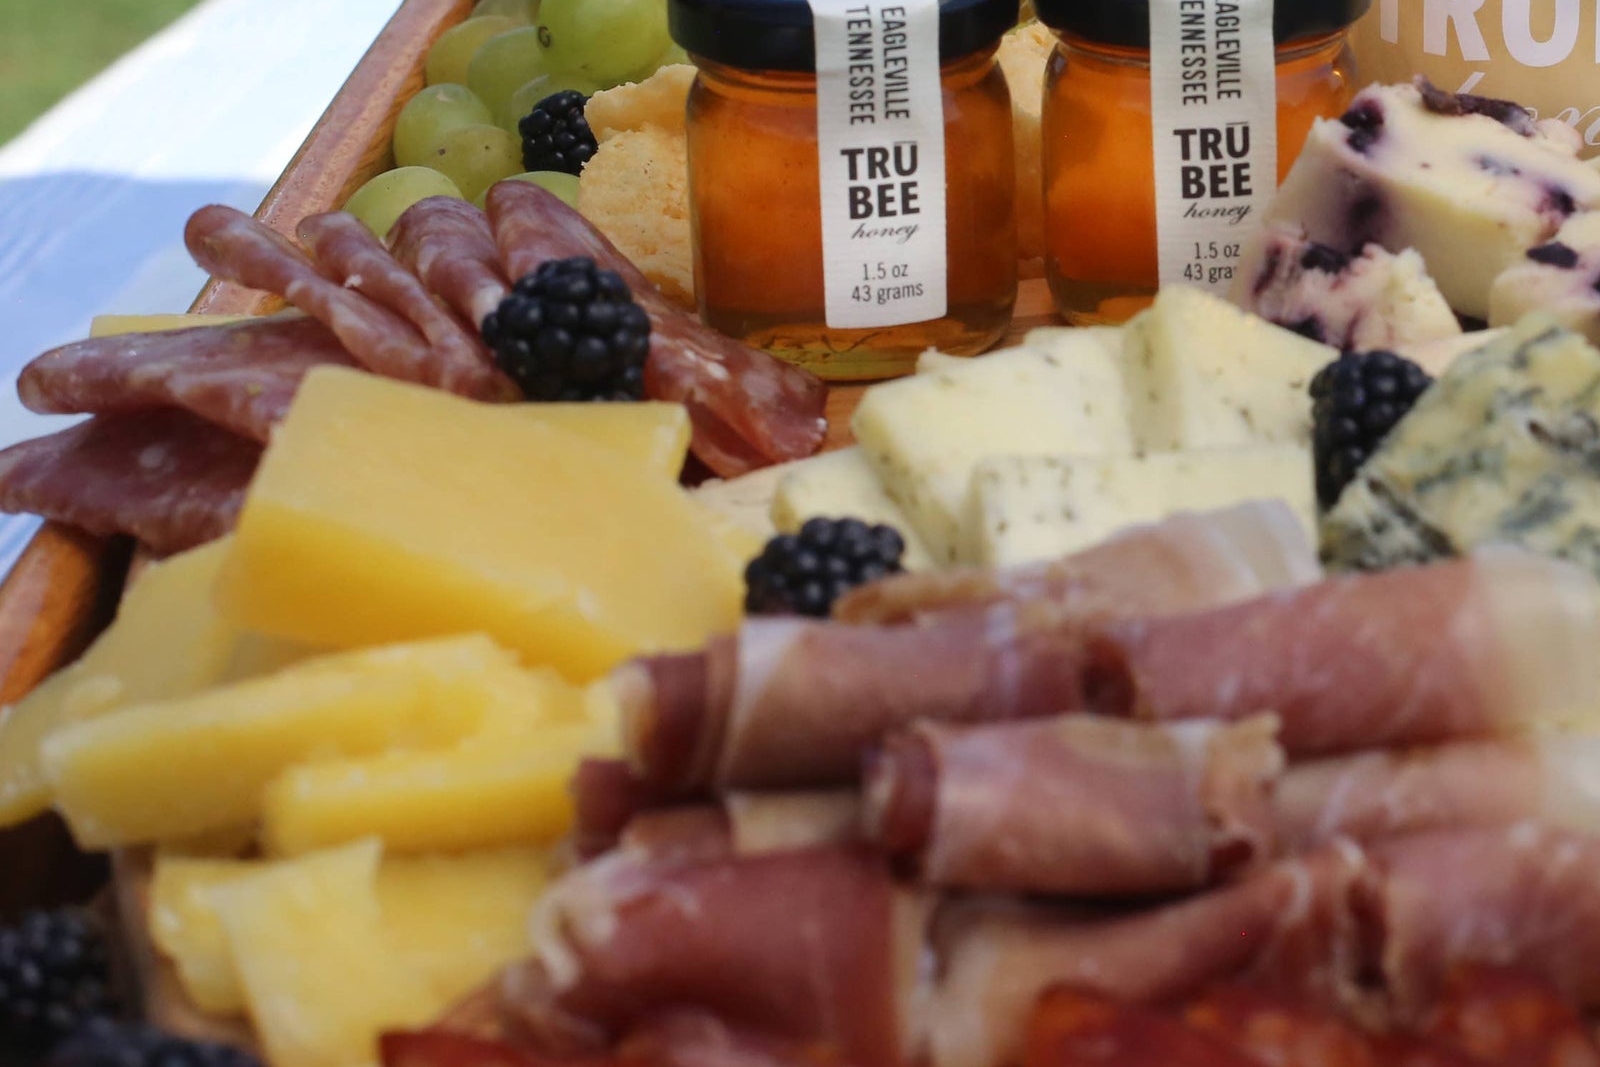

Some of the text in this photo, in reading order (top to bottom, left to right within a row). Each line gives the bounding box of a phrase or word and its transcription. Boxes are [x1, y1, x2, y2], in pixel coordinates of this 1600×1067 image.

[846, 5, 875, 126] TENNESSEE
[881, 6, 910, 121] EAGLEVILLE
[1181, 162, 1253, 200] BEE
[848, 181, 921, 220] BEE
[1182, 201, 1253, 226] honey
[851, 221, 921, 243] honey
[1194, 241, 1241, 260] 1.5 oz
[863, 264, 909, 282] 1.5 oz
[1184, 262, 1238, 285] 43 gra
[851, 282, 924, 305] 43 grams
